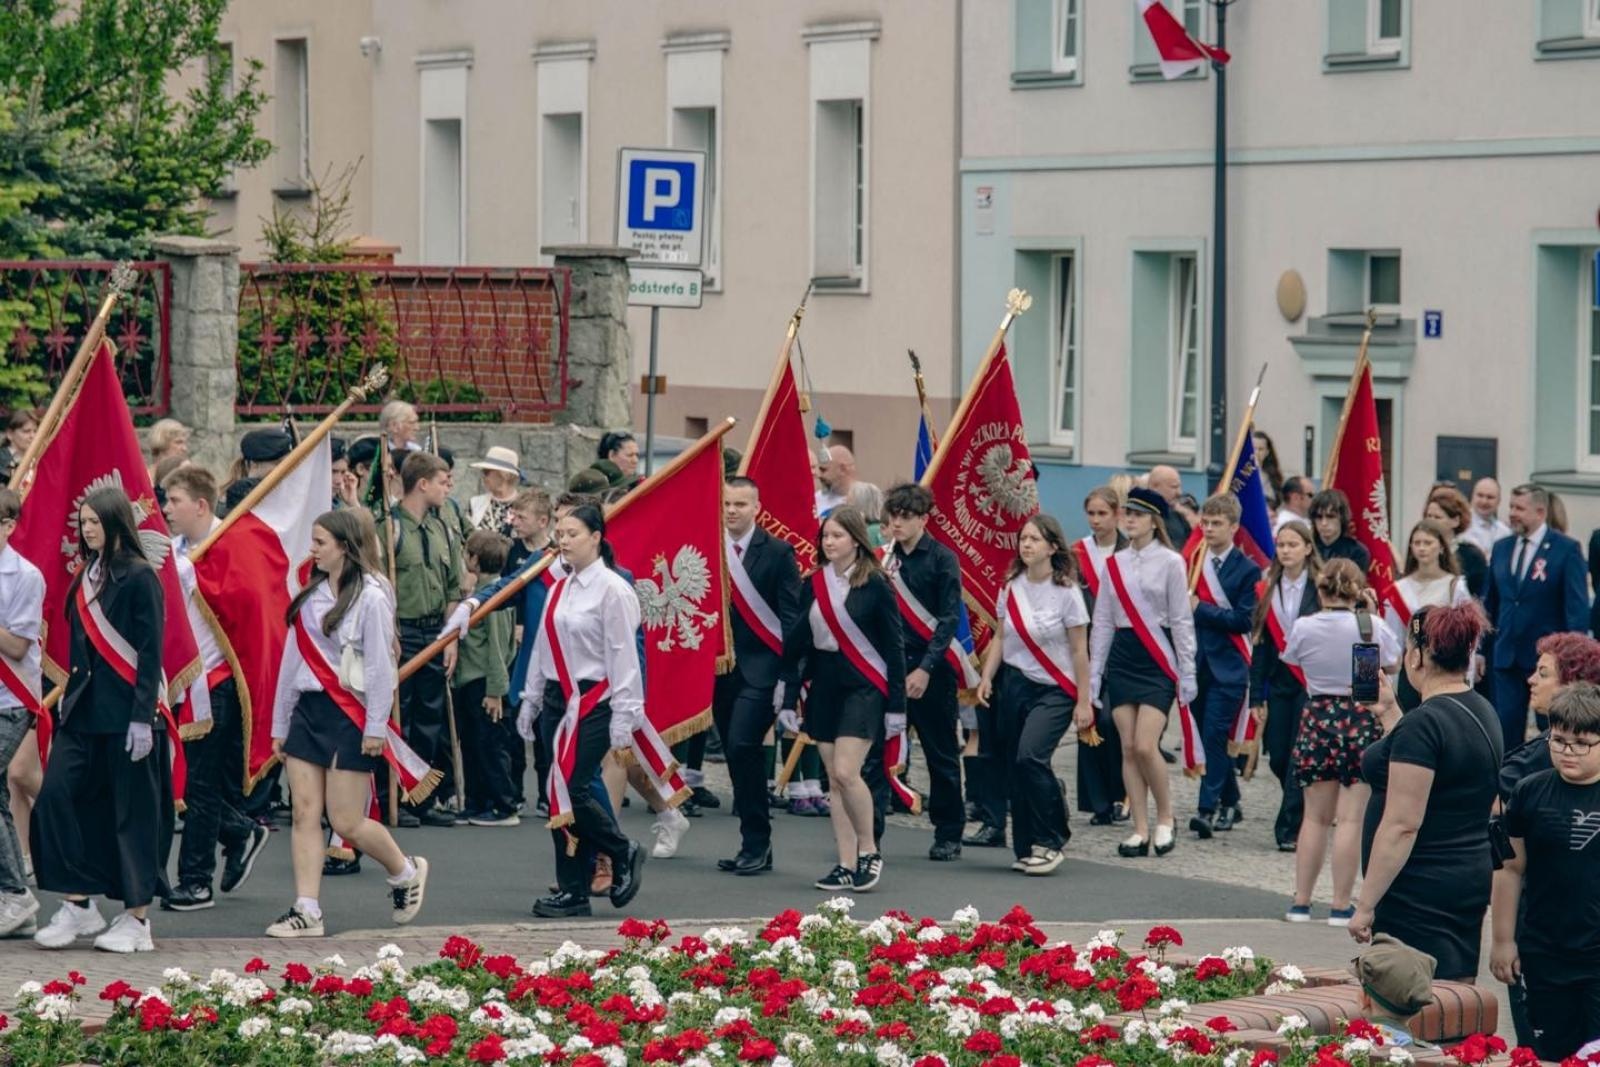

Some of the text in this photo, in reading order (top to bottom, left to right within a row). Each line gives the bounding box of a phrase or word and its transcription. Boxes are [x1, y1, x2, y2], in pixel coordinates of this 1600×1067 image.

[643, 167, 681, 222] P
[629, 280, 698, 297] odstrefa B
[970, 421, 1011, 452] SZKOŁA
